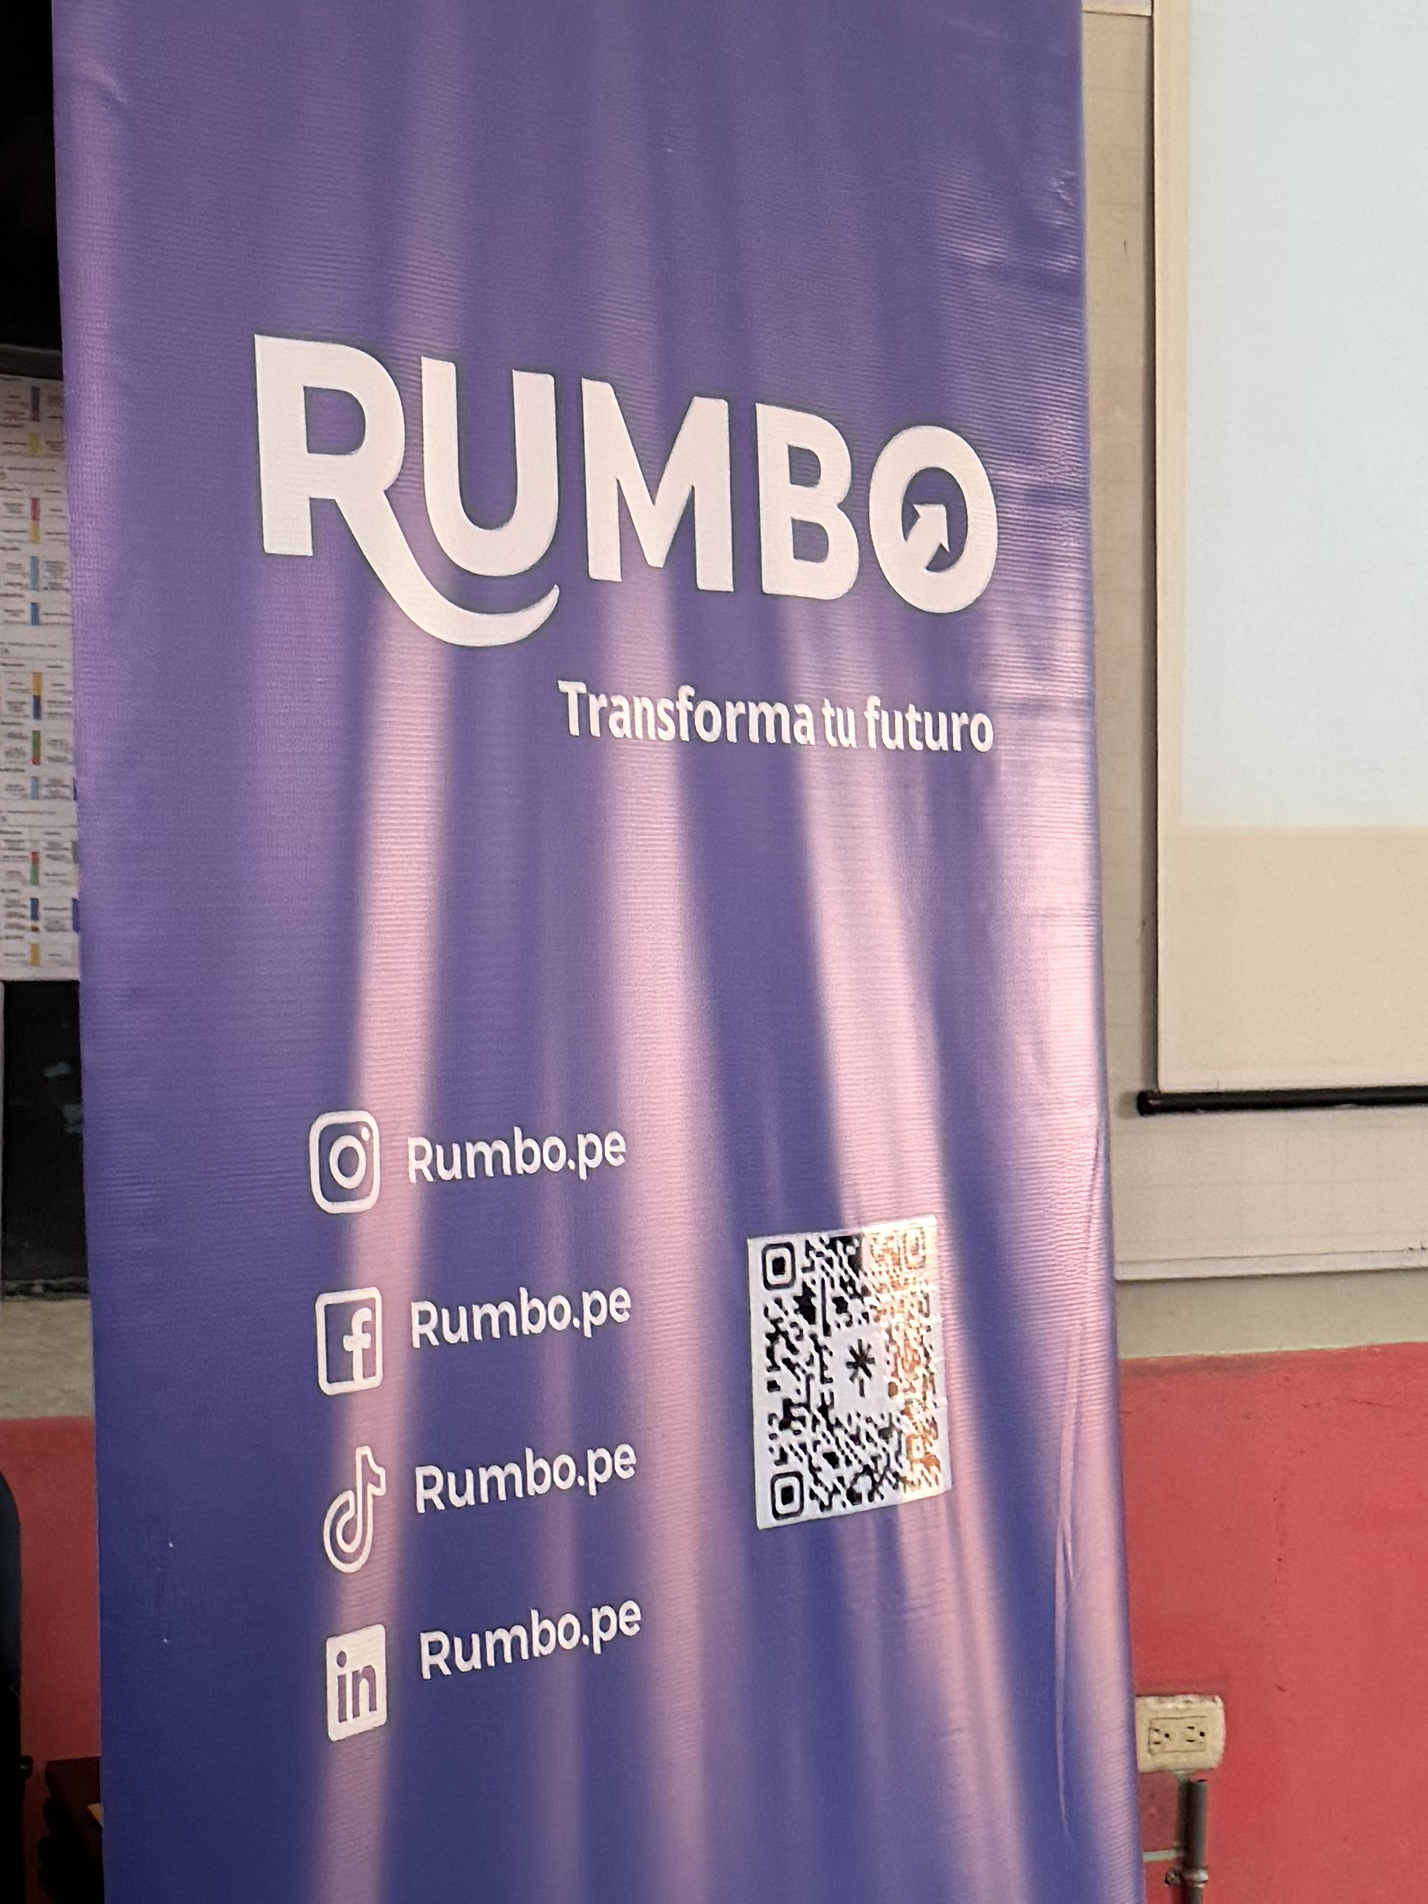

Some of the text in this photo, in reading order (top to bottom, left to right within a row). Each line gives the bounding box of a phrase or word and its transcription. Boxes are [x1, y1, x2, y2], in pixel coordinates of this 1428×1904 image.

[254, 333, 999, 647] RUMBO
[558, 678, 994, 754] Transforma tu futuro
[407, 1126, 627, 1184] Rumbo.pe
[411, 1286, 632, 1349] Rumbo.pe
[414, 1443, 637, 1514] Rumbo.pe
[420, 1599, 642, 1679] Rumbo.pe
